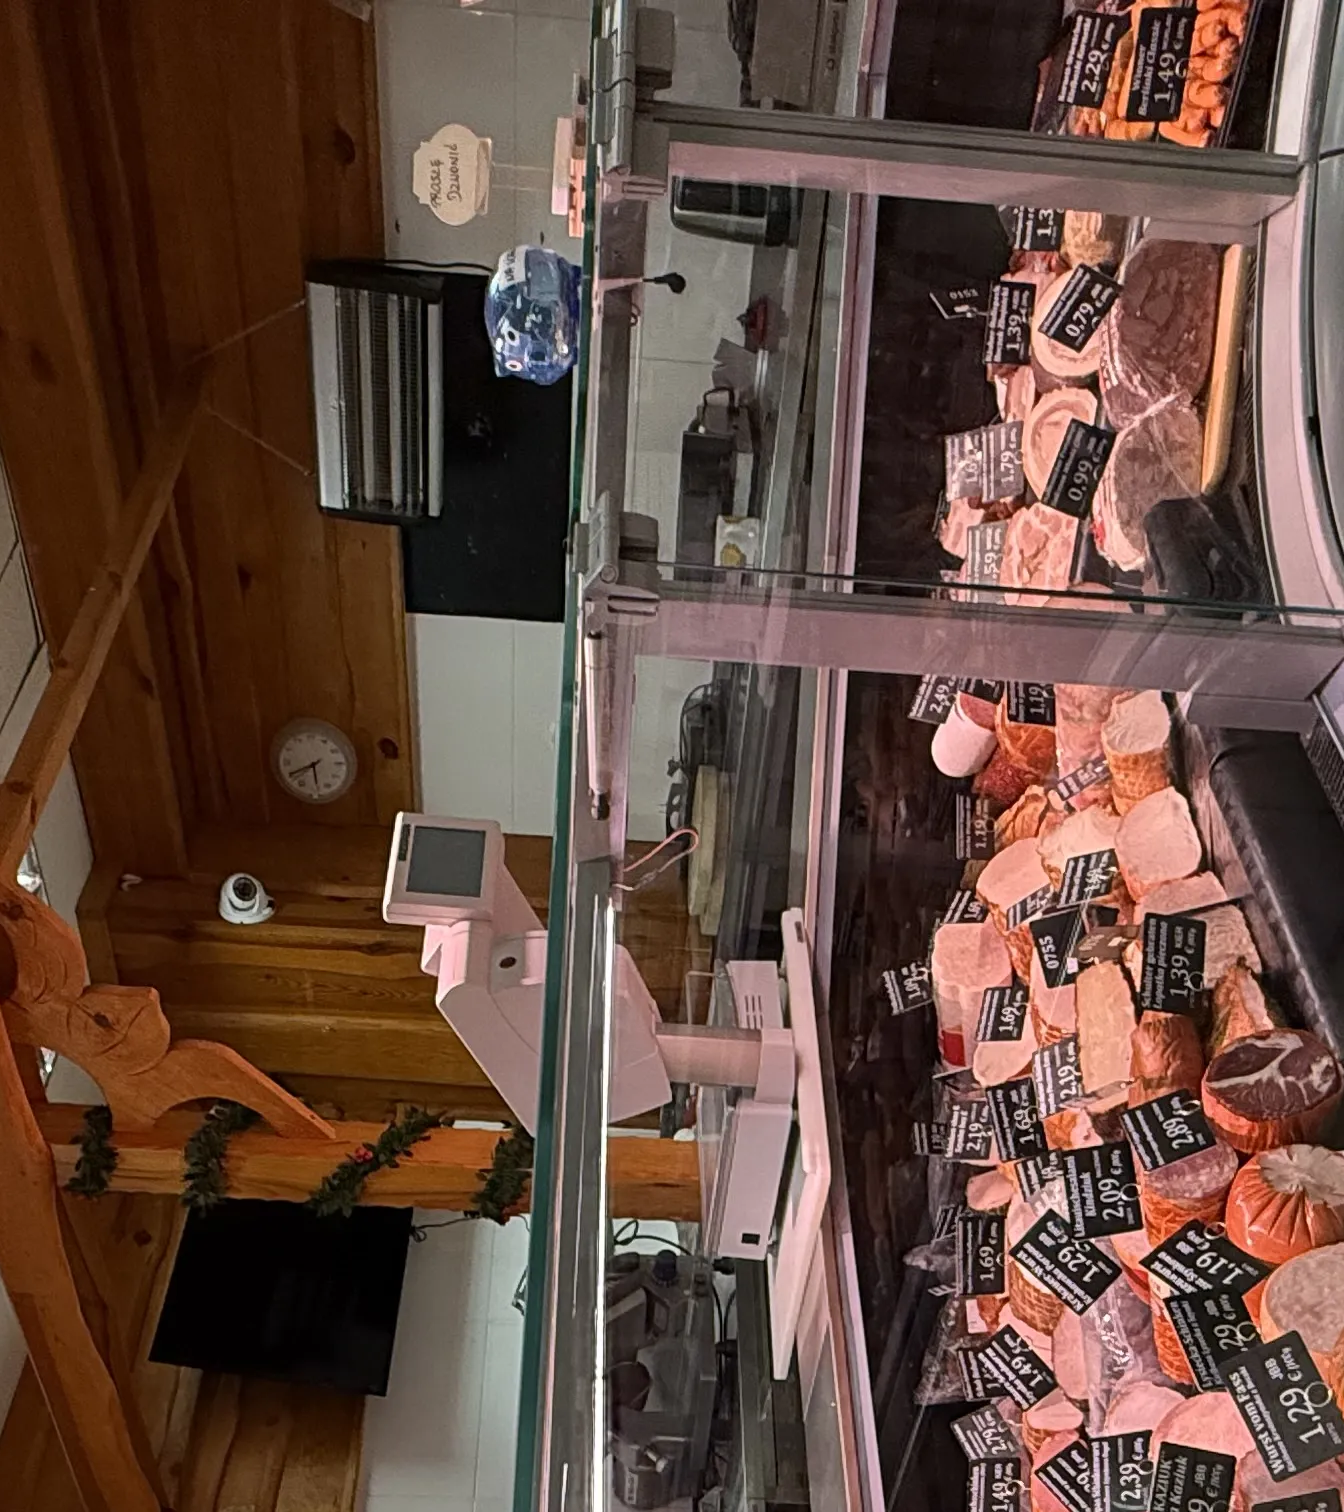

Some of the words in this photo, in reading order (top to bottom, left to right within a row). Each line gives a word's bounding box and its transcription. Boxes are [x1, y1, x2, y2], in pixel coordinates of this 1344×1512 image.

[1080, 49, 1103, 93] 2,29
[1153, 52, 1177, 103] 1,49
[1137, 65, 1155, 117] Berlinki
[1036, 209, 1055, 236] 1,3
[1005, 314, 1022, 351] 1,39
[1064, 302, 1095, 337] 0,79
[999, 450, 1016, 483] 1,79
[1067, 459, 1096, 501] 0,99
[1028, 685, 1046, 715] 1,19
[1038, 934, 1060, 969] 0755
[1140, 966, 1156, 1009] Schulter
[1169, 953, 1191, 997] 1,39
[998, 1006, 1019, 1033] 1,69
[1057, 1065, 1078, 1100] 2,19
[966, 1123, 985, 1152] 2,19
[1013, 1109, 1035, 1144] 1,69
[1162, 1117, 1195, 1149] 2,89
[1097, 1178, 1124, 1221] 2,09
[978, 1245, 996, 1282] 1,69
[1057, 1245, 1101, 1283] 1,29
[1195, 1251, 1242, 1285] 1,19
[1213, 1324, 1248, 1351] ,29
[1010, 1355, 1045, 1388] 1,49
[1228, 1371, 1251, 1402] Fass
[1264, 1356, 1284, 1382] JBB
[1244, 1402, 1267, 1430] vom
[1277, 1386, 1328, 1444] 1,29
[1258, 1431, 1286, 1474] Wurst
[1118, 1462, 1143, 1503] 2,39
[1168, 1454, 1189, 1505] Kaziuk
[1194, 1464, 1207, 1488] JBB
[991, 1481, 1011, 1512] 1,49
